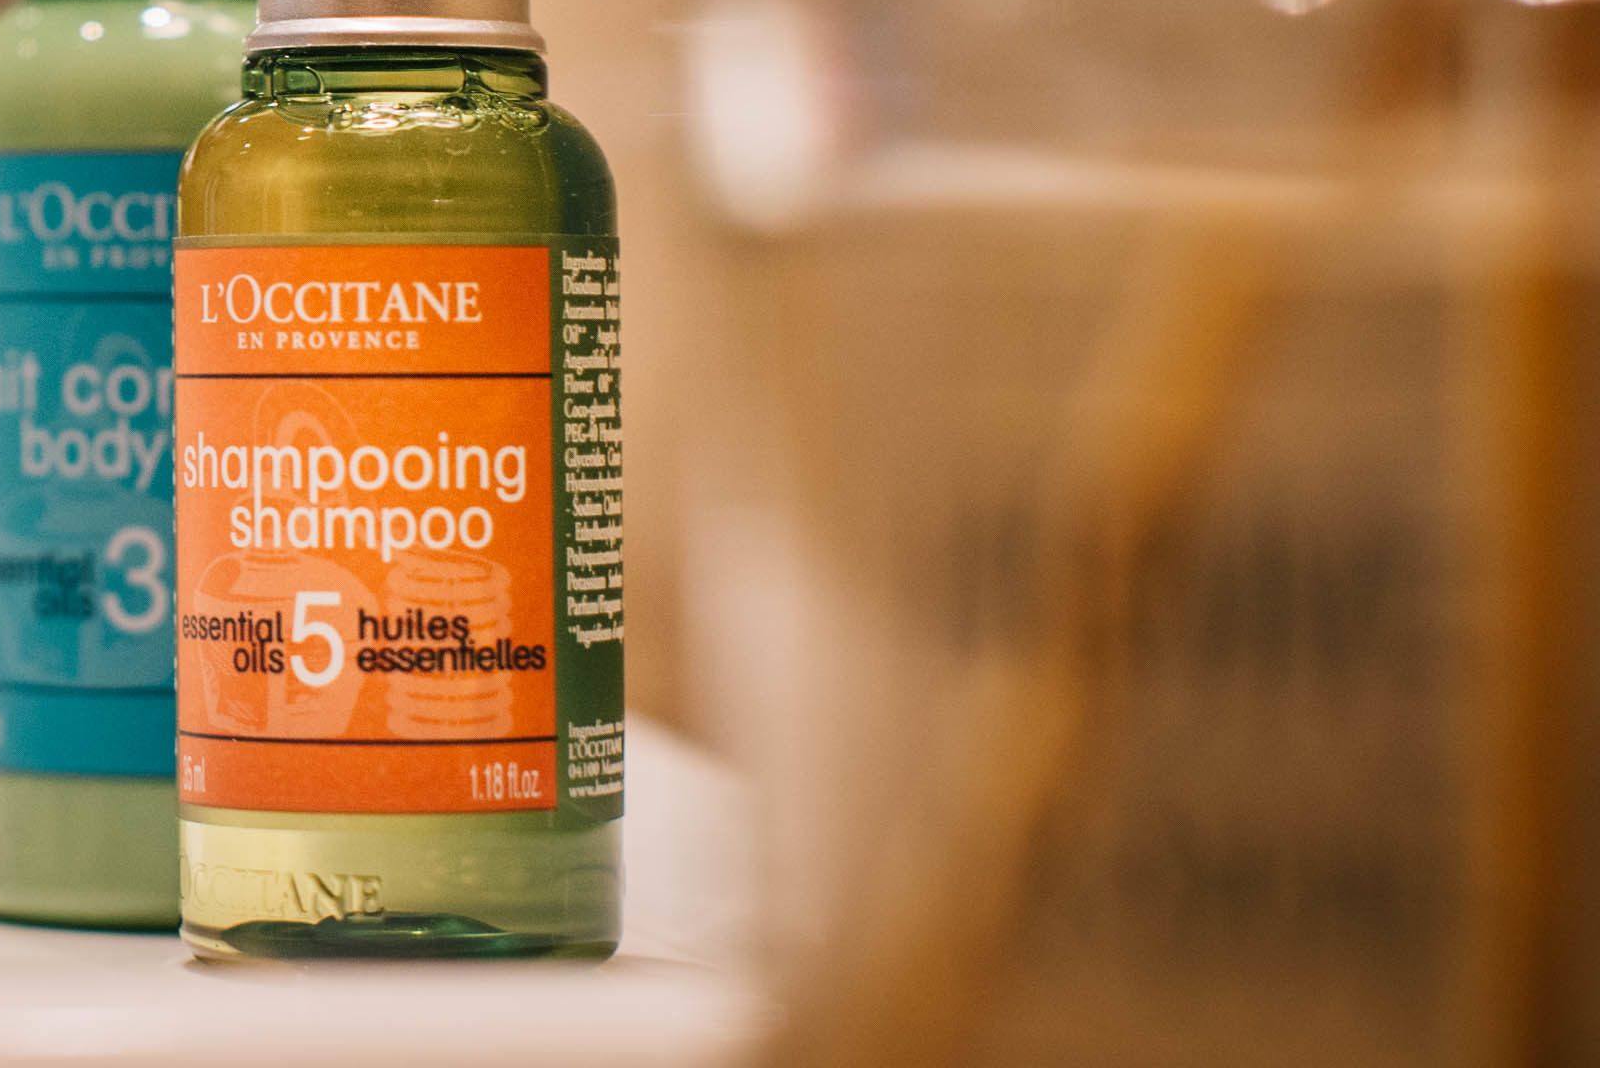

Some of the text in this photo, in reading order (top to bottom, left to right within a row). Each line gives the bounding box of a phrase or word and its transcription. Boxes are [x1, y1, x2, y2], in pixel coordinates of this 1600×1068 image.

[200, 273, 482, 325] L'OCCITANE
[237, 329, 421, 351] EN PROVENCE
[20, 416, 170, 494] body
[182, 431, 528, 504] shampooing
[229, 490, 493, 563] shampoo
[102, 524, 170, 636] 3
[181, 591, 470, 688] essential 5 huiles
[232, 638, 286, 675] oils
[355, 638, 547, 674] essentielles
[468, 763, 504, 801] 1.18
